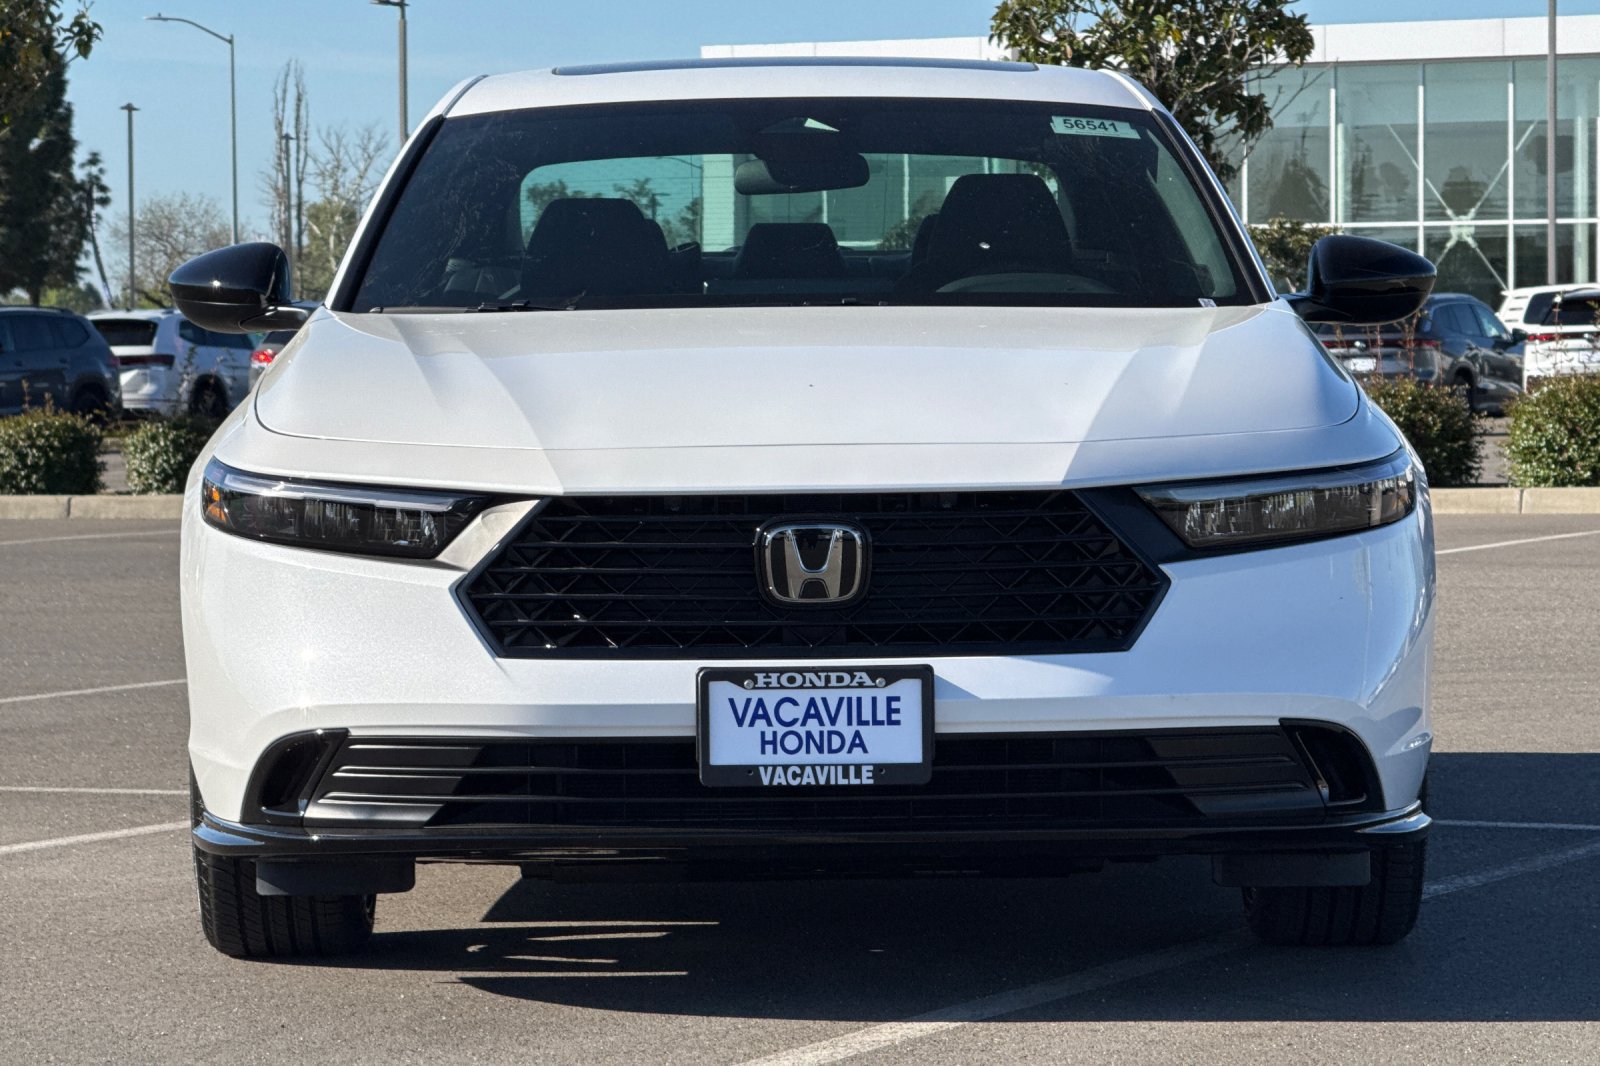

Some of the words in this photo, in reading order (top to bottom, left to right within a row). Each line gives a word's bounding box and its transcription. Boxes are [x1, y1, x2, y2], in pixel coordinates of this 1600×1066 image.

[1062, 118, 1118, 132] 56541
[754, 672, 876, 688] HONDA
[728, 696, 901, 727] VACAVILLE
[760, 730, 868, 755] HONDA
[758, 765, 874, 785] VACAVILLE
